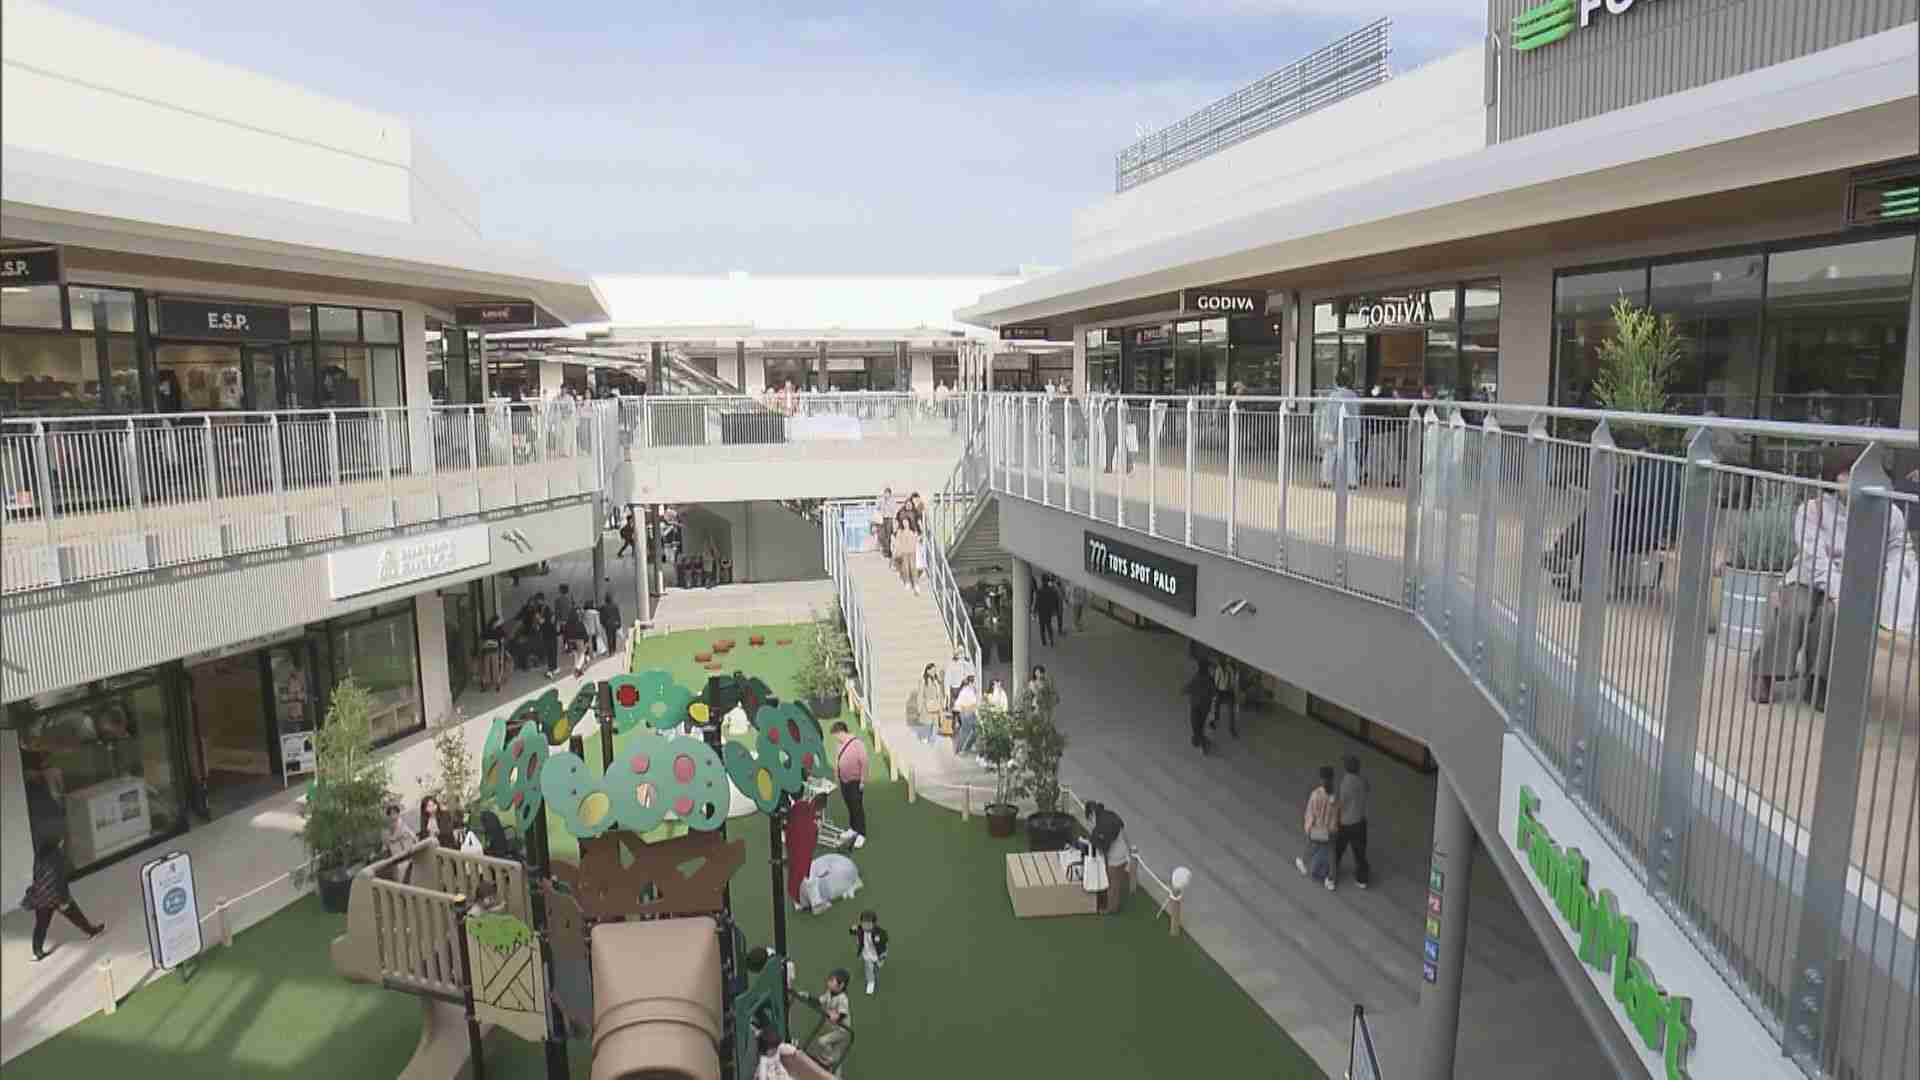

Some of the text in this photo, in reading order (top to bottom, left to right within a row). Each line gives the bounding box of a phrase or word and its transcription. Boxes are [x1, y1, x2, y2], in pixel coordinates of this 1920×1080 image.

[1197, 296, 1254, 311] GODIVA
[1359, 300, 1425, 327] GODIVA
[207, 312, 249, 330] E.S.P.
[1109, 554, 1176, 595] TOYS SPOT PALO
